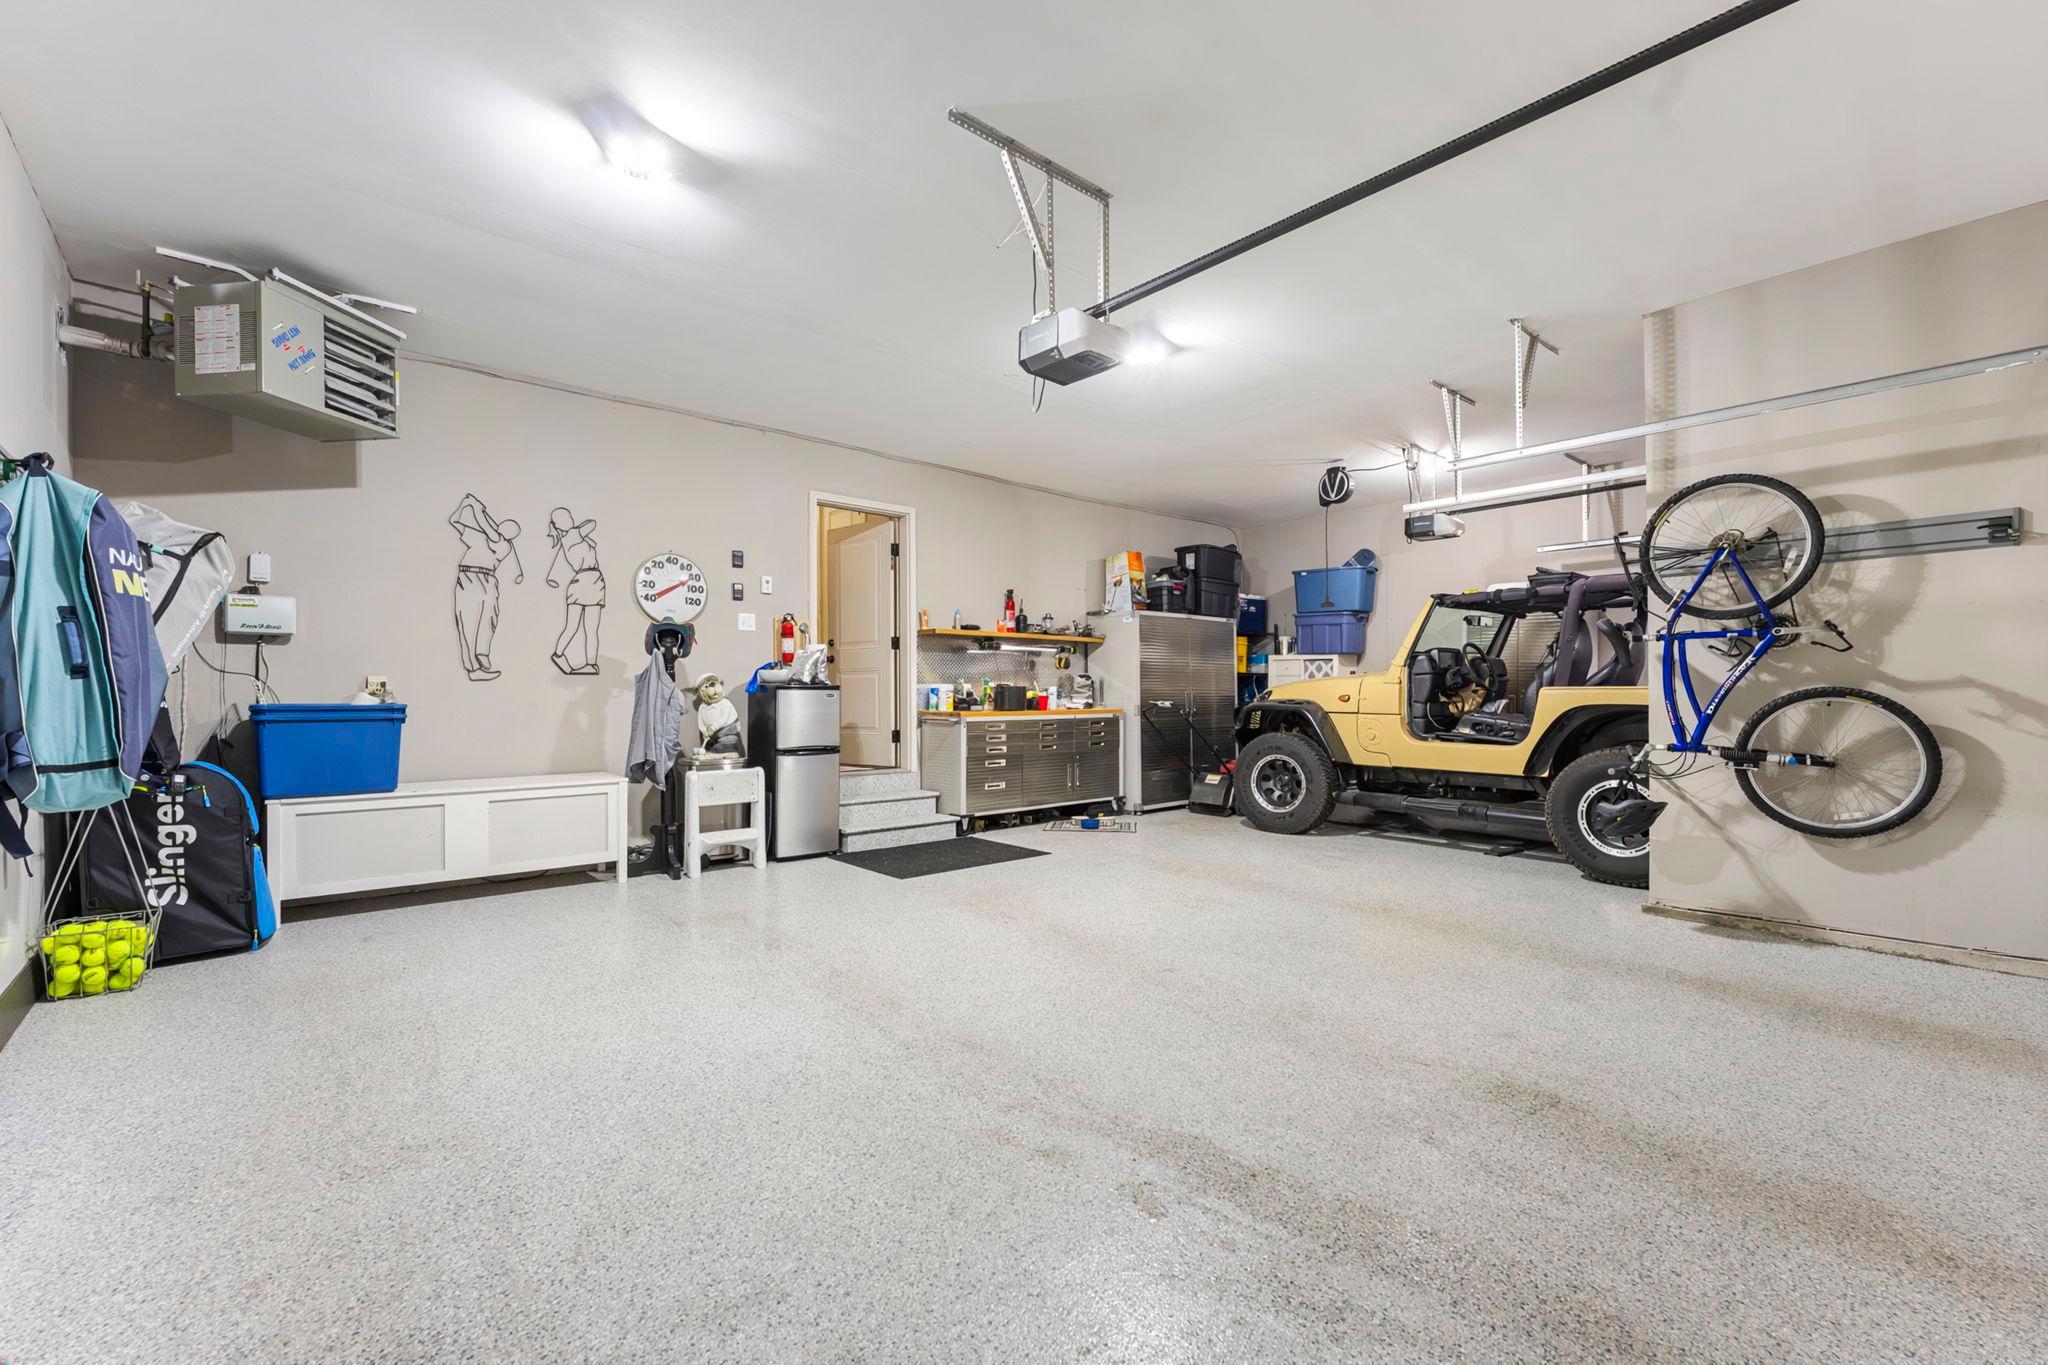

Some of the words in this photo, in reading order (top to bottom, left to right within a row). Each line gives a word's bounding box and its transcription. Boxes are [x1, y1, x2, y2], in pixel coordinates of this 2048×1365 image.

[651, 560, 665, 569] 20
[665, 556, 679, 565] 40
[644, 566, 651, 575] 0
[679, 562, 693, 571] 60
[687, 584, 705, 594] 100
[685, 596, 702, 606] 120
